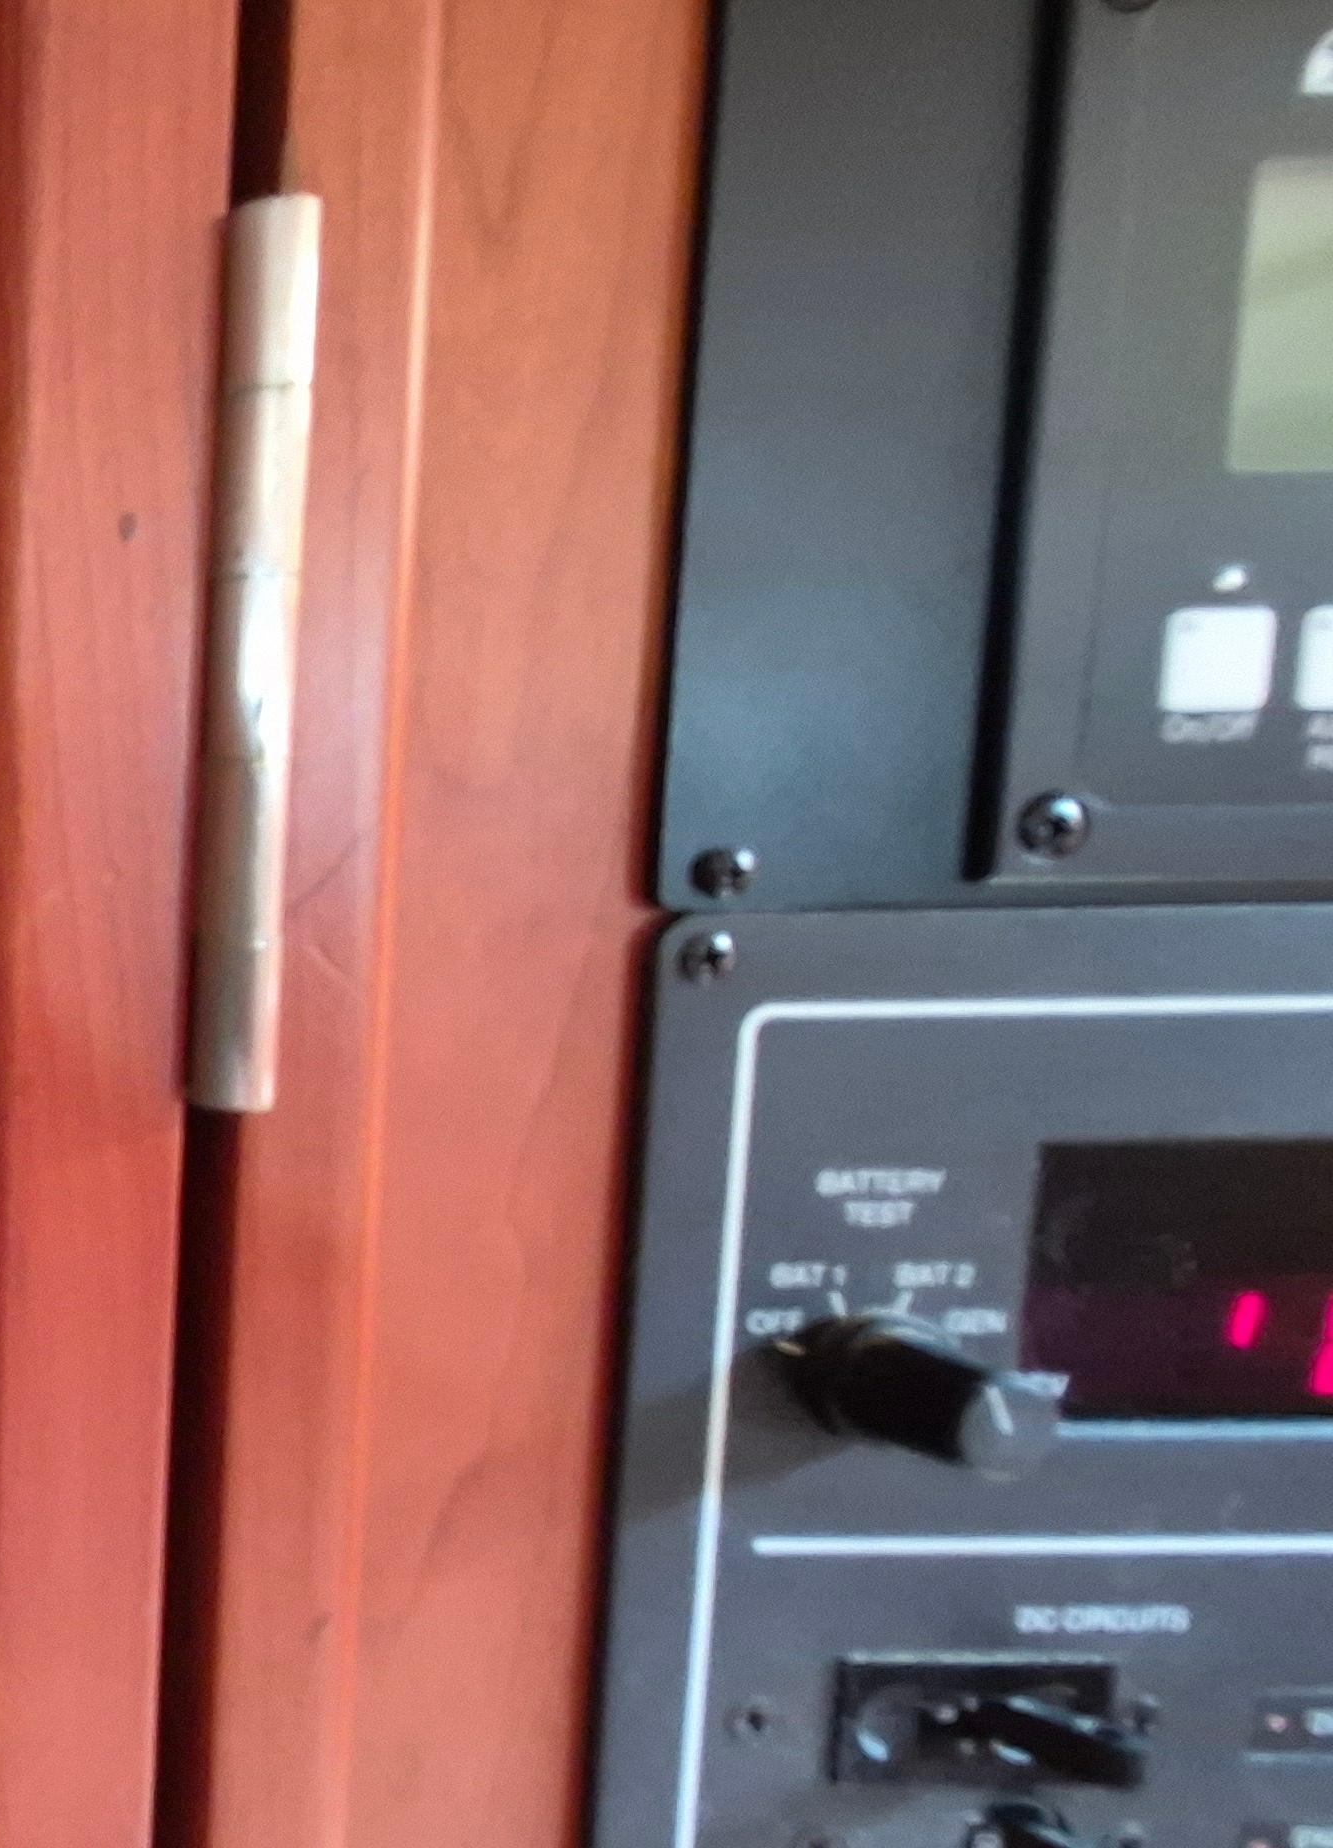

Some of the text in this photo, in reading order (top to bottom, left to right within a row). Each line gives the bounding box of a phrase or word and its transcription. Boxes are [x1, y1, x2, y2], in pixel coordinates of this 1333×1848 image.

[814, 1168, 947, 1197] BATTERY
[843, 1200, 915, 1228] TEST
[769, 1261, 848, 1289] BAT 1
[893, 1261, 977, 1289] BAT 2
[941, 1307, 1008, 1334] GEN
[1014, 1603, 1192, 1634] DC CIRCUITS
